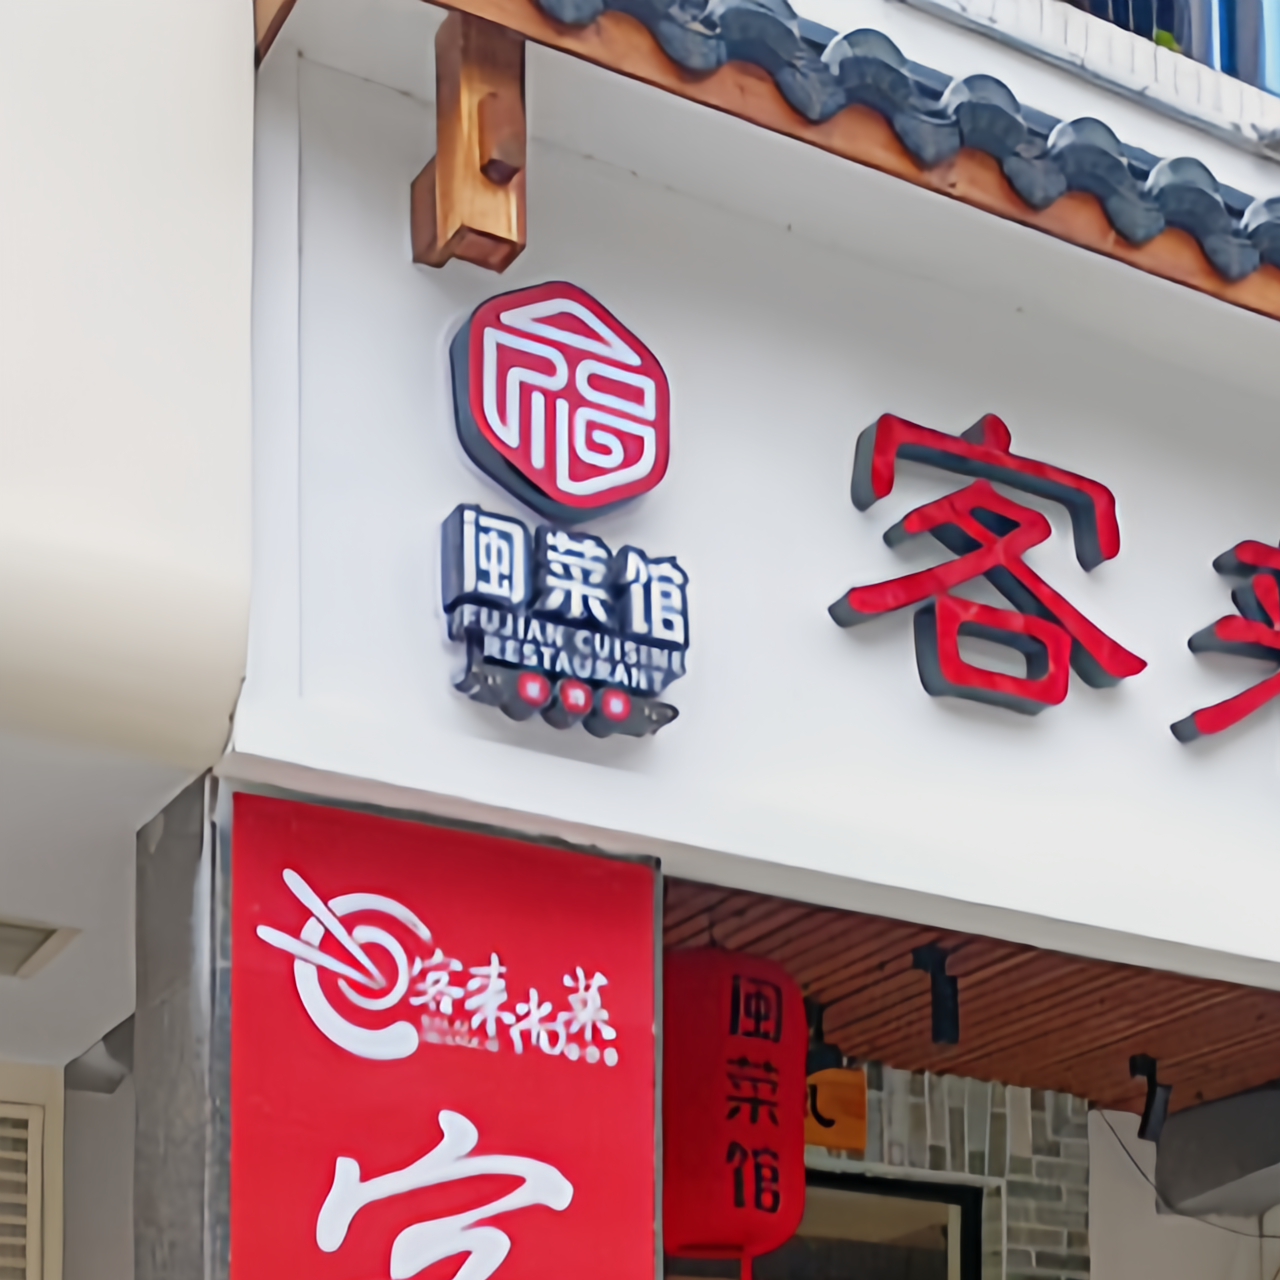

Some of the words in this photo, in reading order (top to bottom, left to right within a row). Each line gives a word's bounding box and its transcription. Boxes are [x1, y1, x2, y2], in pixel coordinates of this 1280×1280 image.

[462, 508, 687, 647] 闽菜馆
[725, 973, 783, 1214] 闽菜馆
